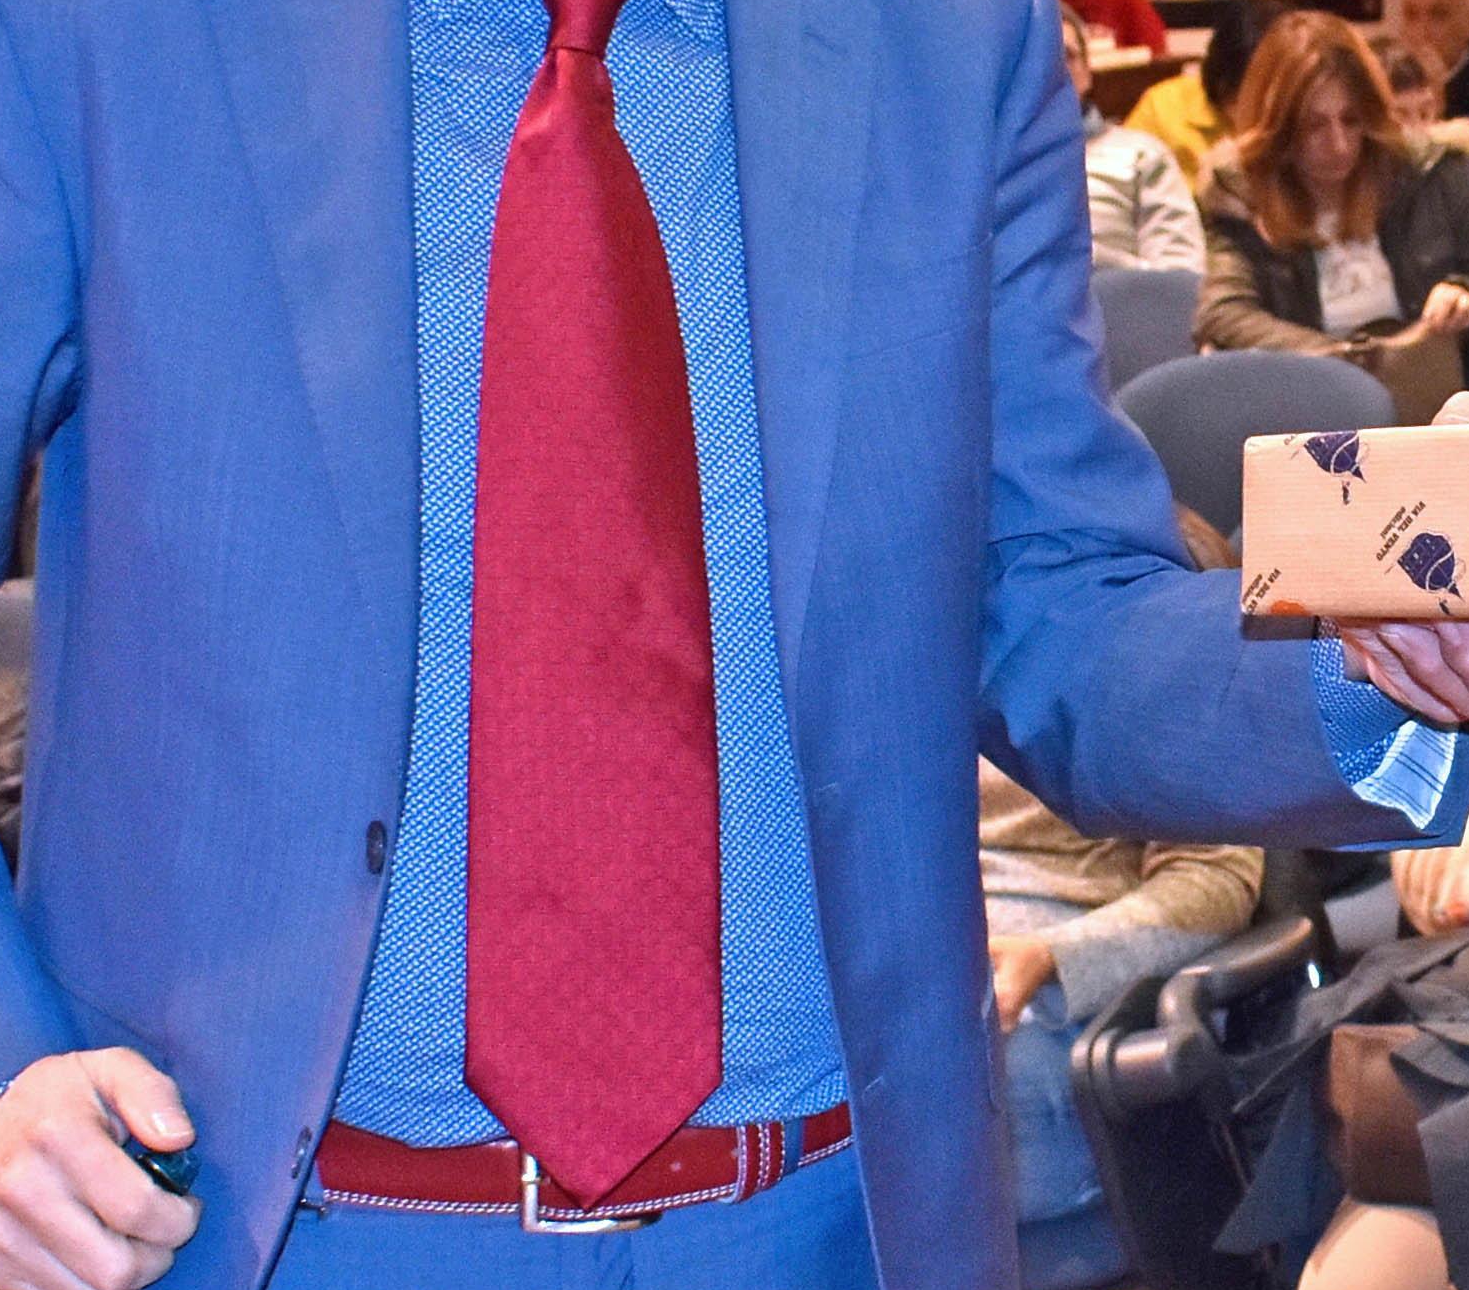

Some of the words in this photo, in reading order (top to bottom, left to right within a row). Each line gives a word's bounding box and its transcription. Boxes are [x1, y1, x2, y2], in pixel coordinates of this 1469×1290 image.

[1411, 500, 1426, 516] VIA
[1397, 515, 1413, 532] DEL
[1376, 532, 1399, 561] VENTO
[1267, 568, 1281, 583] VIA
